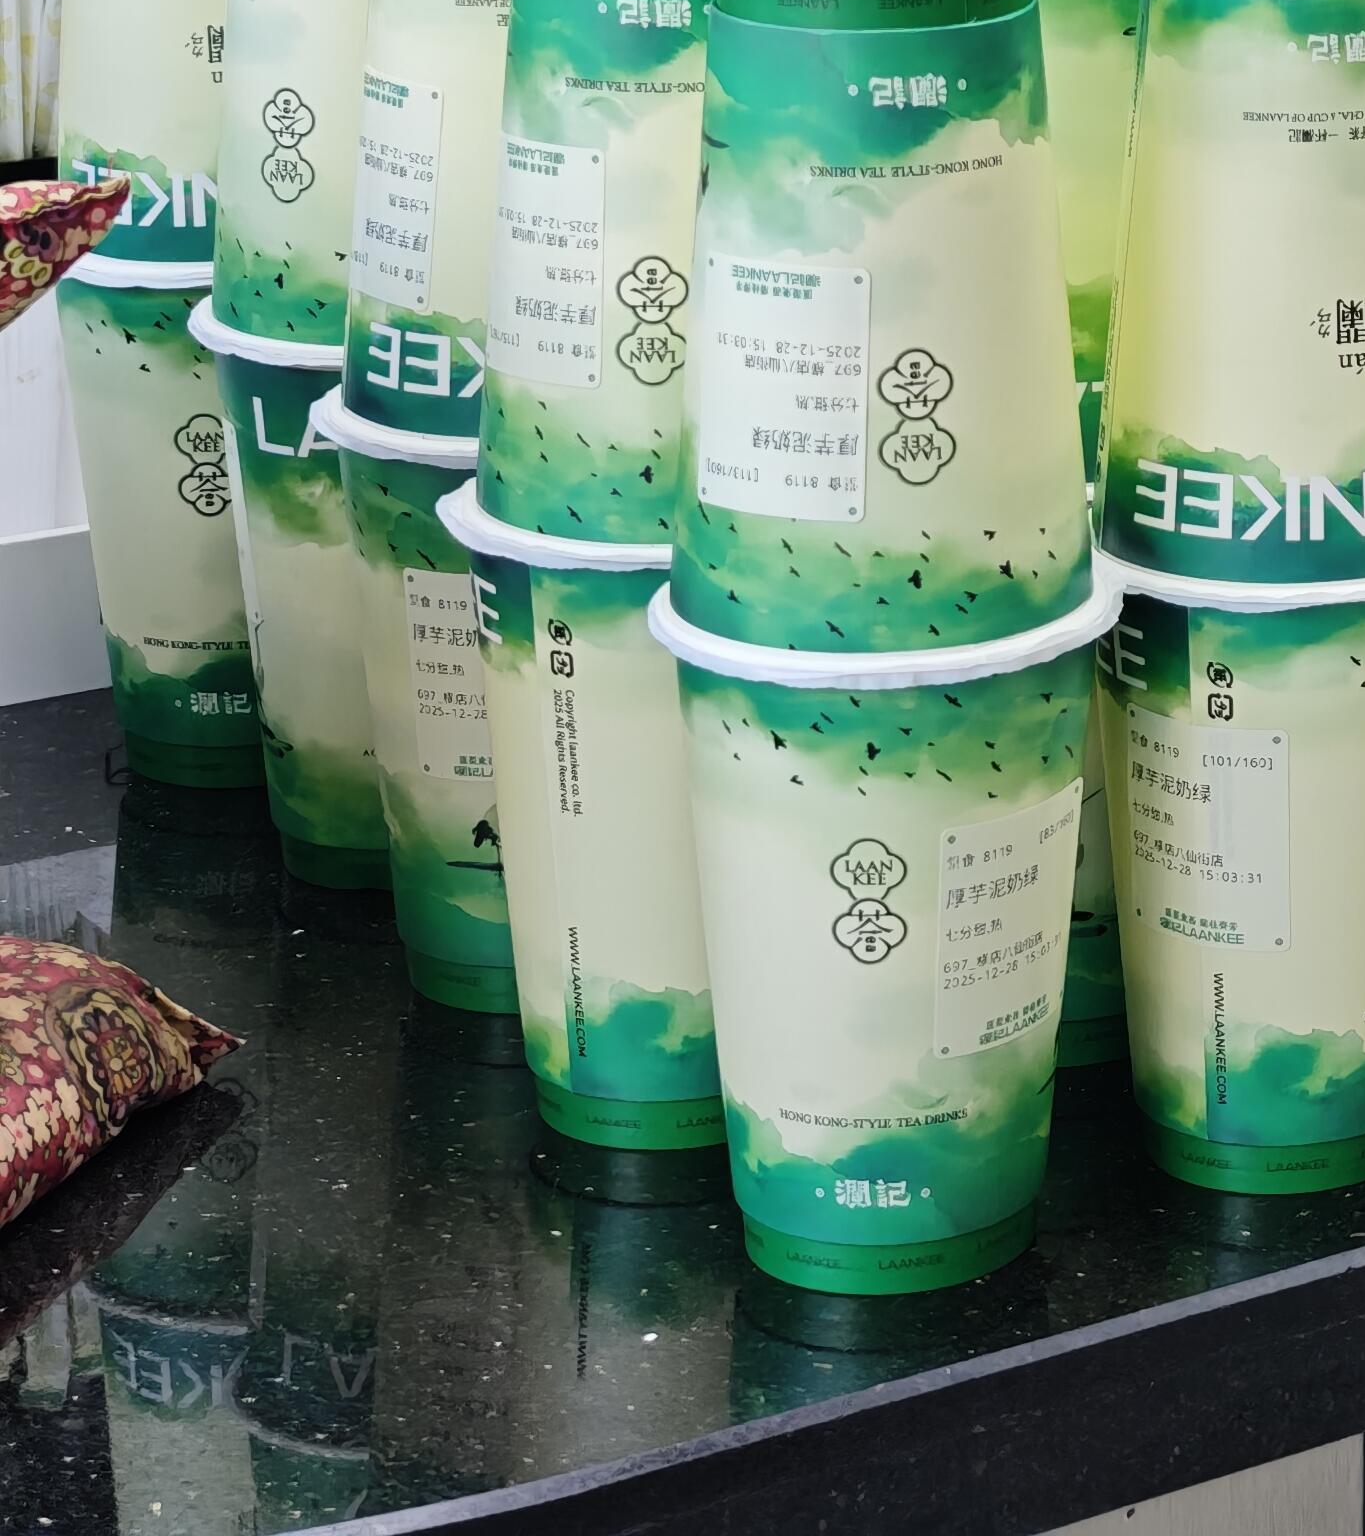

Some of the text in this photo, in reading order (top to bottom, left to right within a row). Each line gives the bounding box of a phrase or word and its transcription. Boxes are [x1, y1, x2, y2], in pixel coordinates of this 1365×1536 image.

[565, 77, 630, 92] TEA DRINKS
[1243, 112, 1329, 122] CUP LAANKEE
[810, 155, 1002, 178] HONG KONG-STYLE TEA DRINKS
[751, 426, 859, 457] 厚芋泥奶绿
[784, 474, 819, 488] 8119
[565, 690, 580, 781] Copyright laankee
[553, 689, 569, 813] 2025 Rights Reserved.
[1202, 754, 1273, 770] [101/160]
[843, 858, 895, 876] LAAN
[1200, 869, 1262, 884] 15:03:31
[568, 927, 587, 1057] WWW.LAANKEE.COM
[1212, 972, 1228, 1107] WWW.LAANKEE.COM
[779, 1107, 969, 1130] HONG KONG-STYLE TEA DRINKS
[835, 1179, 912, 1209] 瀾記
